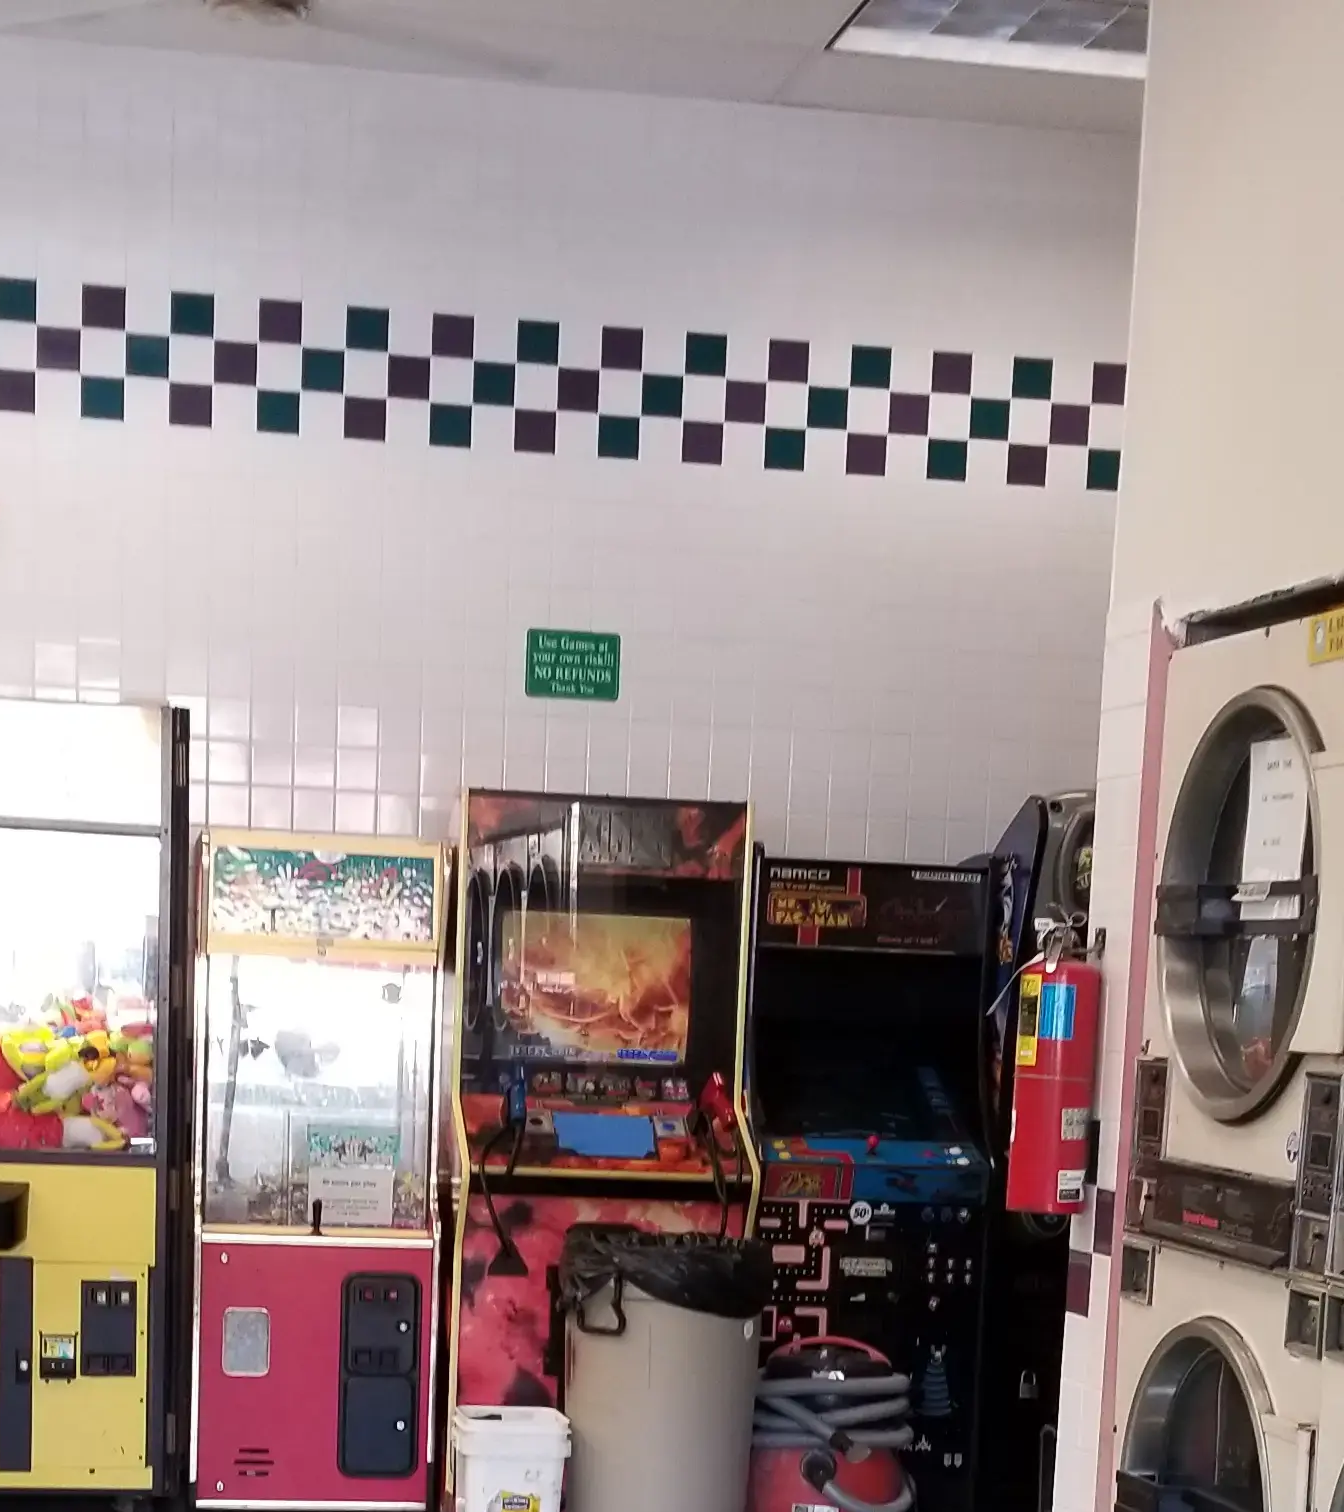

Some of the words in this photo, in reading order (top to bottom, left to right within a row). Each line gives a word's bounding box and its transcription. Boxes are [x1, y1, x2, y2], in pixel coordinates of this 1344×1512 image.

[538, 634, 558, 648] Use
[559, 654, 581, 665] own
[534, 665, 552, 680] NO
[555, 667, 612, 683] REFUNDS
[769, 867, 831, 881] namco
